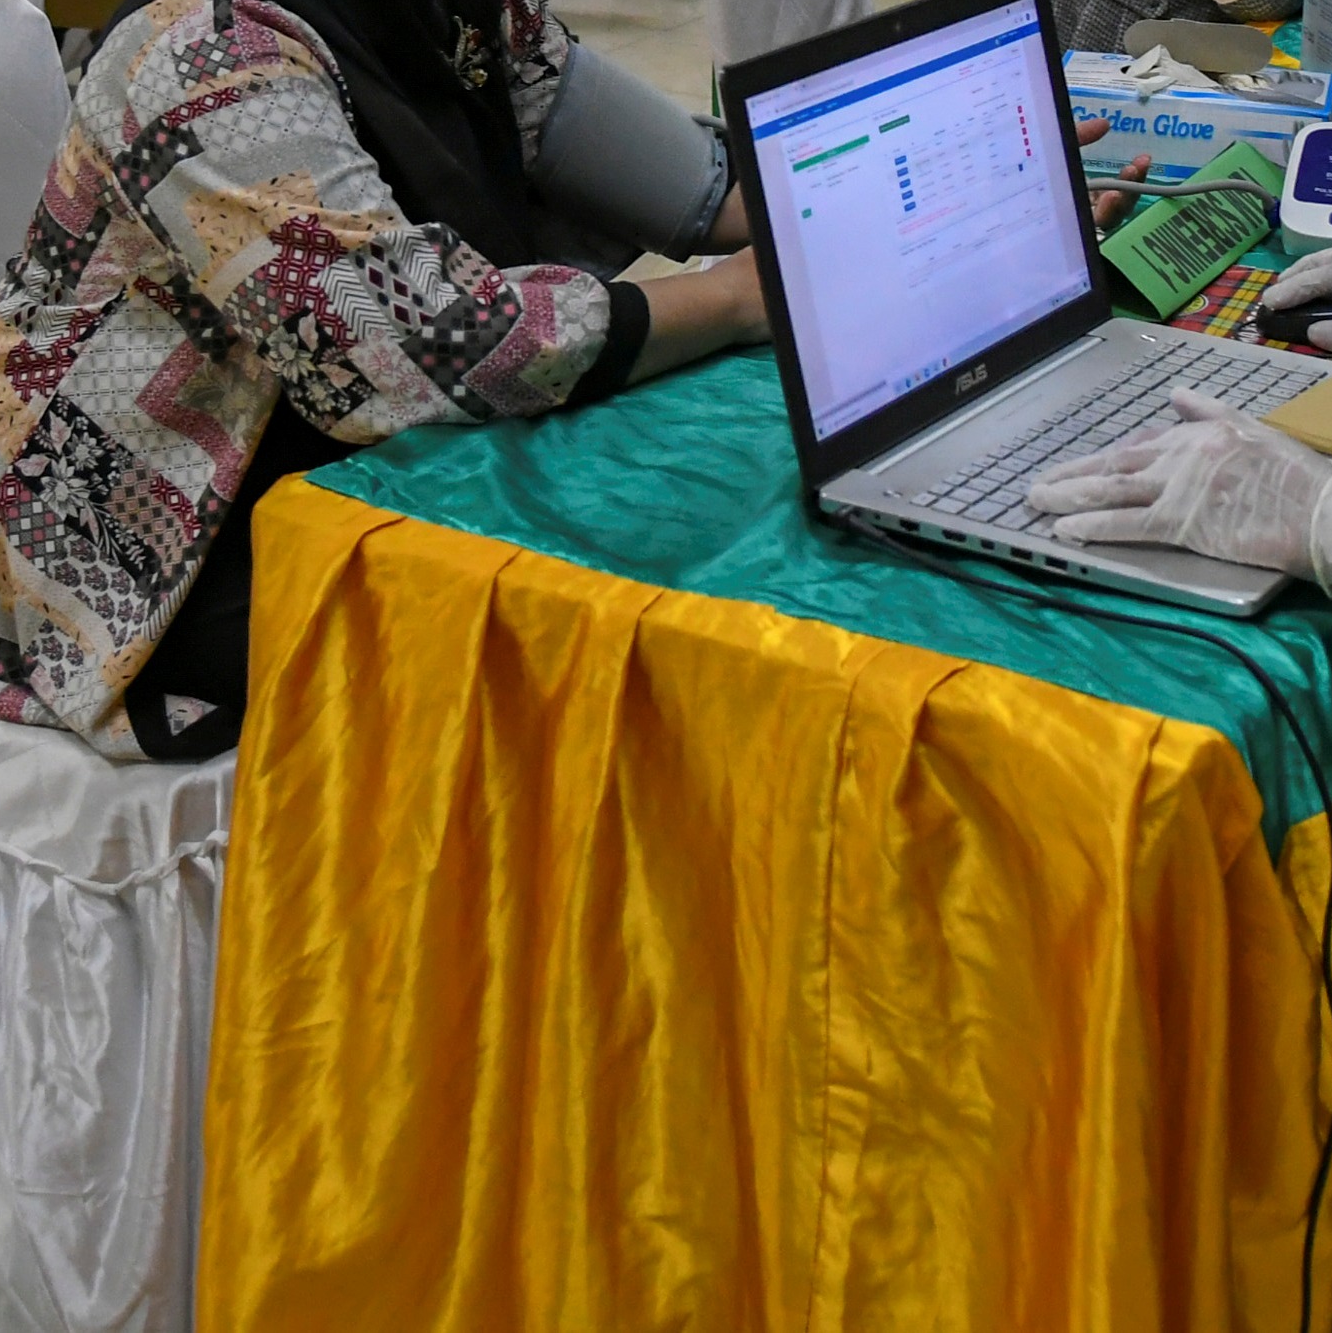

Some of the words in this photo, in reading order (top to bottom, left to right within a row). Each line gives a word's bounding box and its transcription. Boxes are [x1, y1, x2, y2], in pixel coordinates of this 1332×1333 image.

[1153, 114, 1215, 140] Glove
[1142, 191, 1251, 285] SCREENING
[1131, 244, 1179, 294] 1
[955, 364, 989, 396] ASUS
